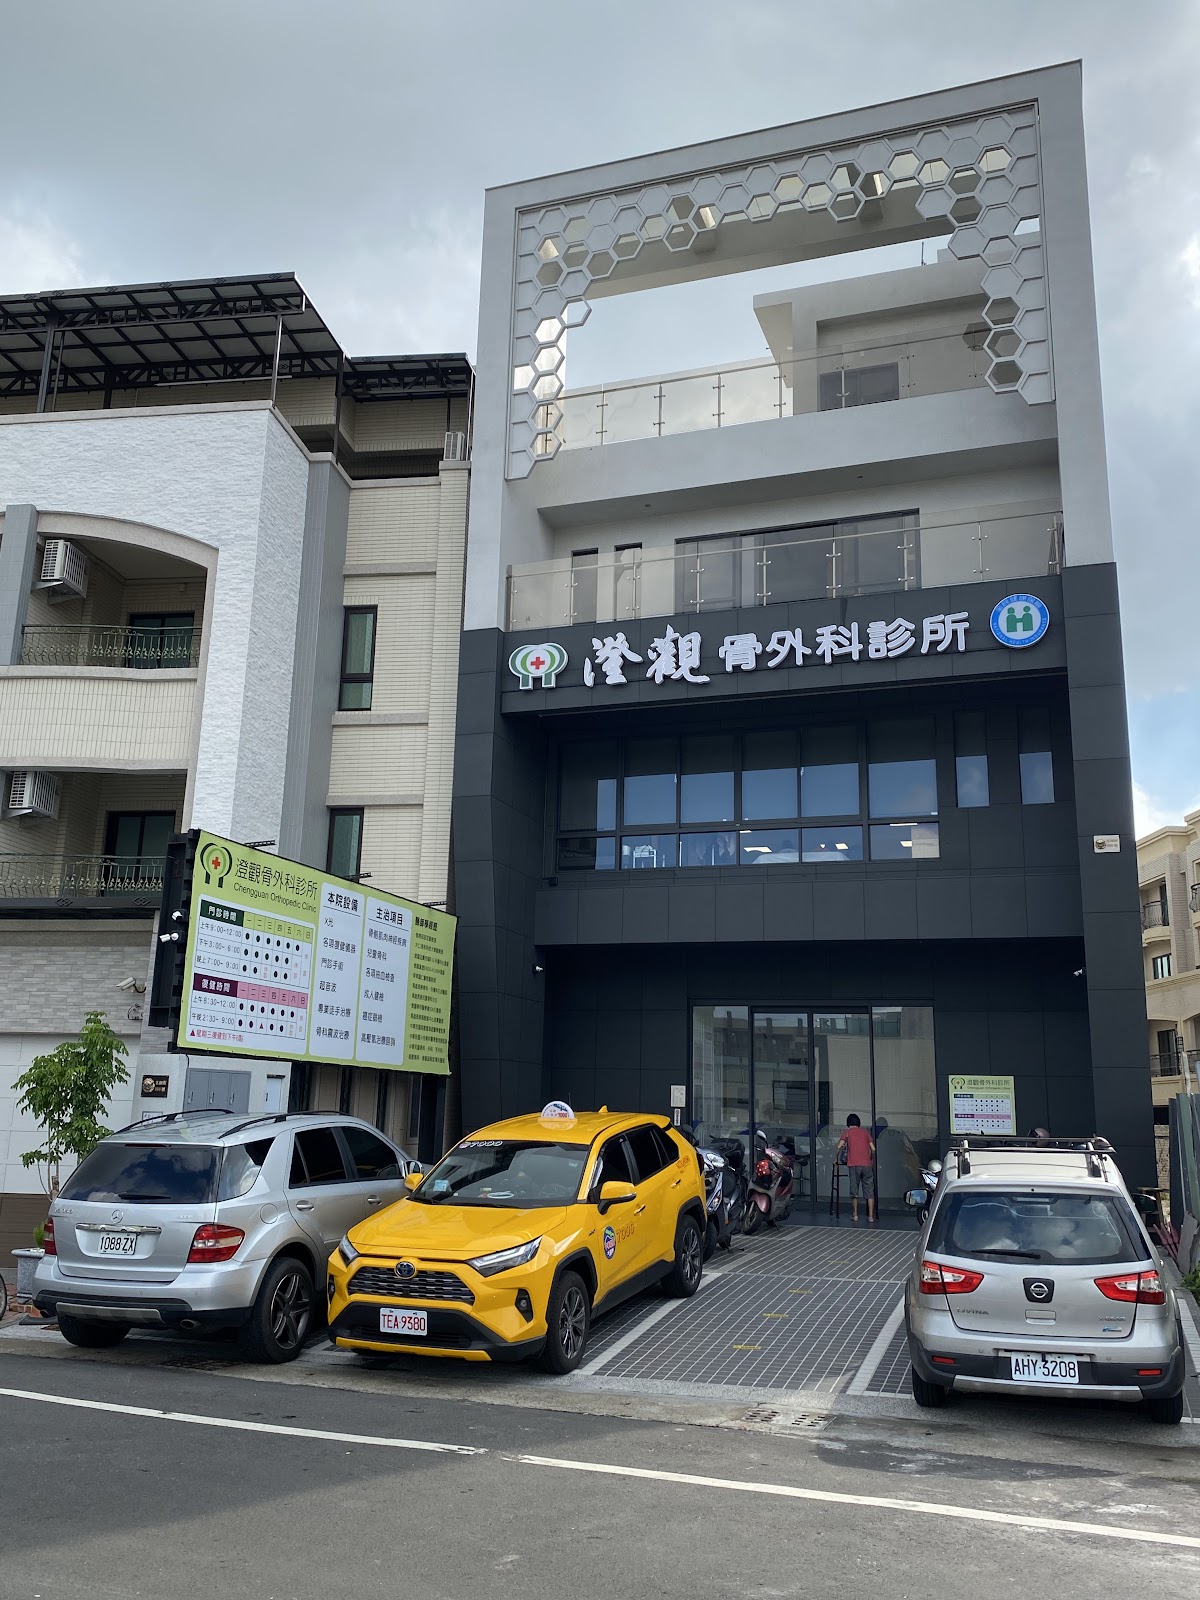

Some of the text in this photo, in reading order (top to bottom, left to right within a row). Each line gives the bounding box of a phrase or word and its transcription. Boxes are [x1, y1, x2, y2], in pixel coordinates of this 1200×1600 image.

[234, 857, 318, 901] 澄觀骨外科診所
[233, 882, 317, 913] Chengguan Orthopedic Clinic
[327, 891, 358, 912] 本院設備
[208, 905, 237, 921] 門診時間
[375, 906, 403, 926] 主治項目
[381, 1313, 426, 1331] TEA-9380
